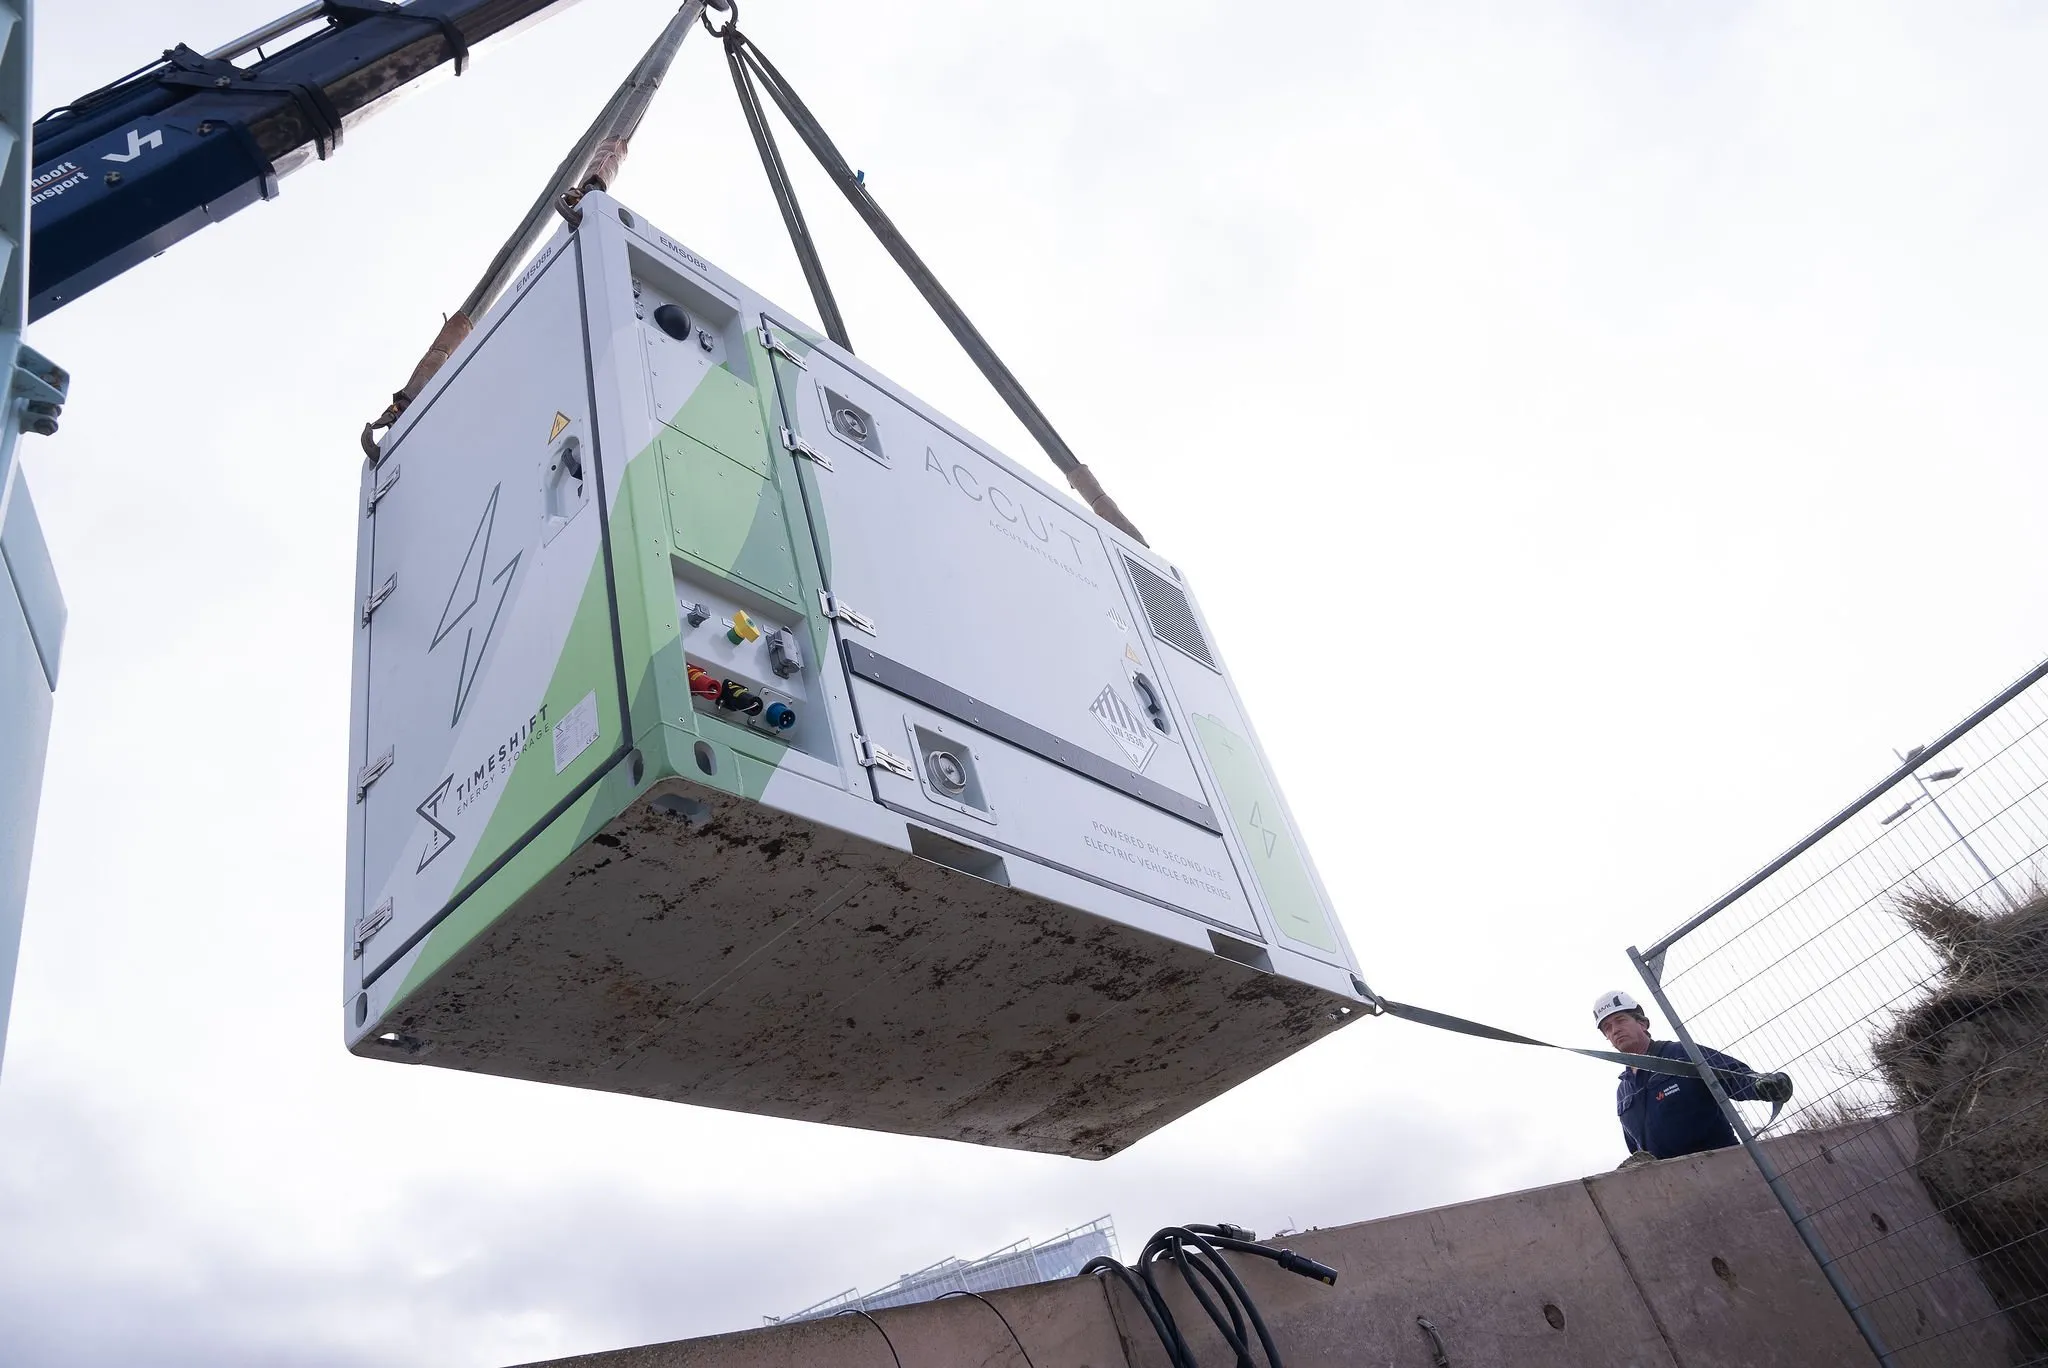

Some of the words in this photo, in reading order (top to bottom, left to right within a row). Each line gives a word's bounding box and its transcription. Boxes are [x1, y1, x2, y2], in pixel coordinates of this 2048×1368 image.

[516, 247, 552, 293] EMS088
[659, 236, 708, 272] EMS088
[456, 703, 548, 801] TIMESHIFT
[456, 775, 495, 816] ENERGY
[500, 722, 550, 775] STORAGE
[1083, 835, 1136, 864] ELECTRIC
[1136, 856, 1181, 881] VEHICLE
[1181, 873, 1232, 901] BATTERIES
[1091, 820, 1145, 849] POWERED
[1146, 843, 1160, 857] BY
[1162, 849, 1202, 873] SECOND
[1202, 866, 1225, 882] LIFE
